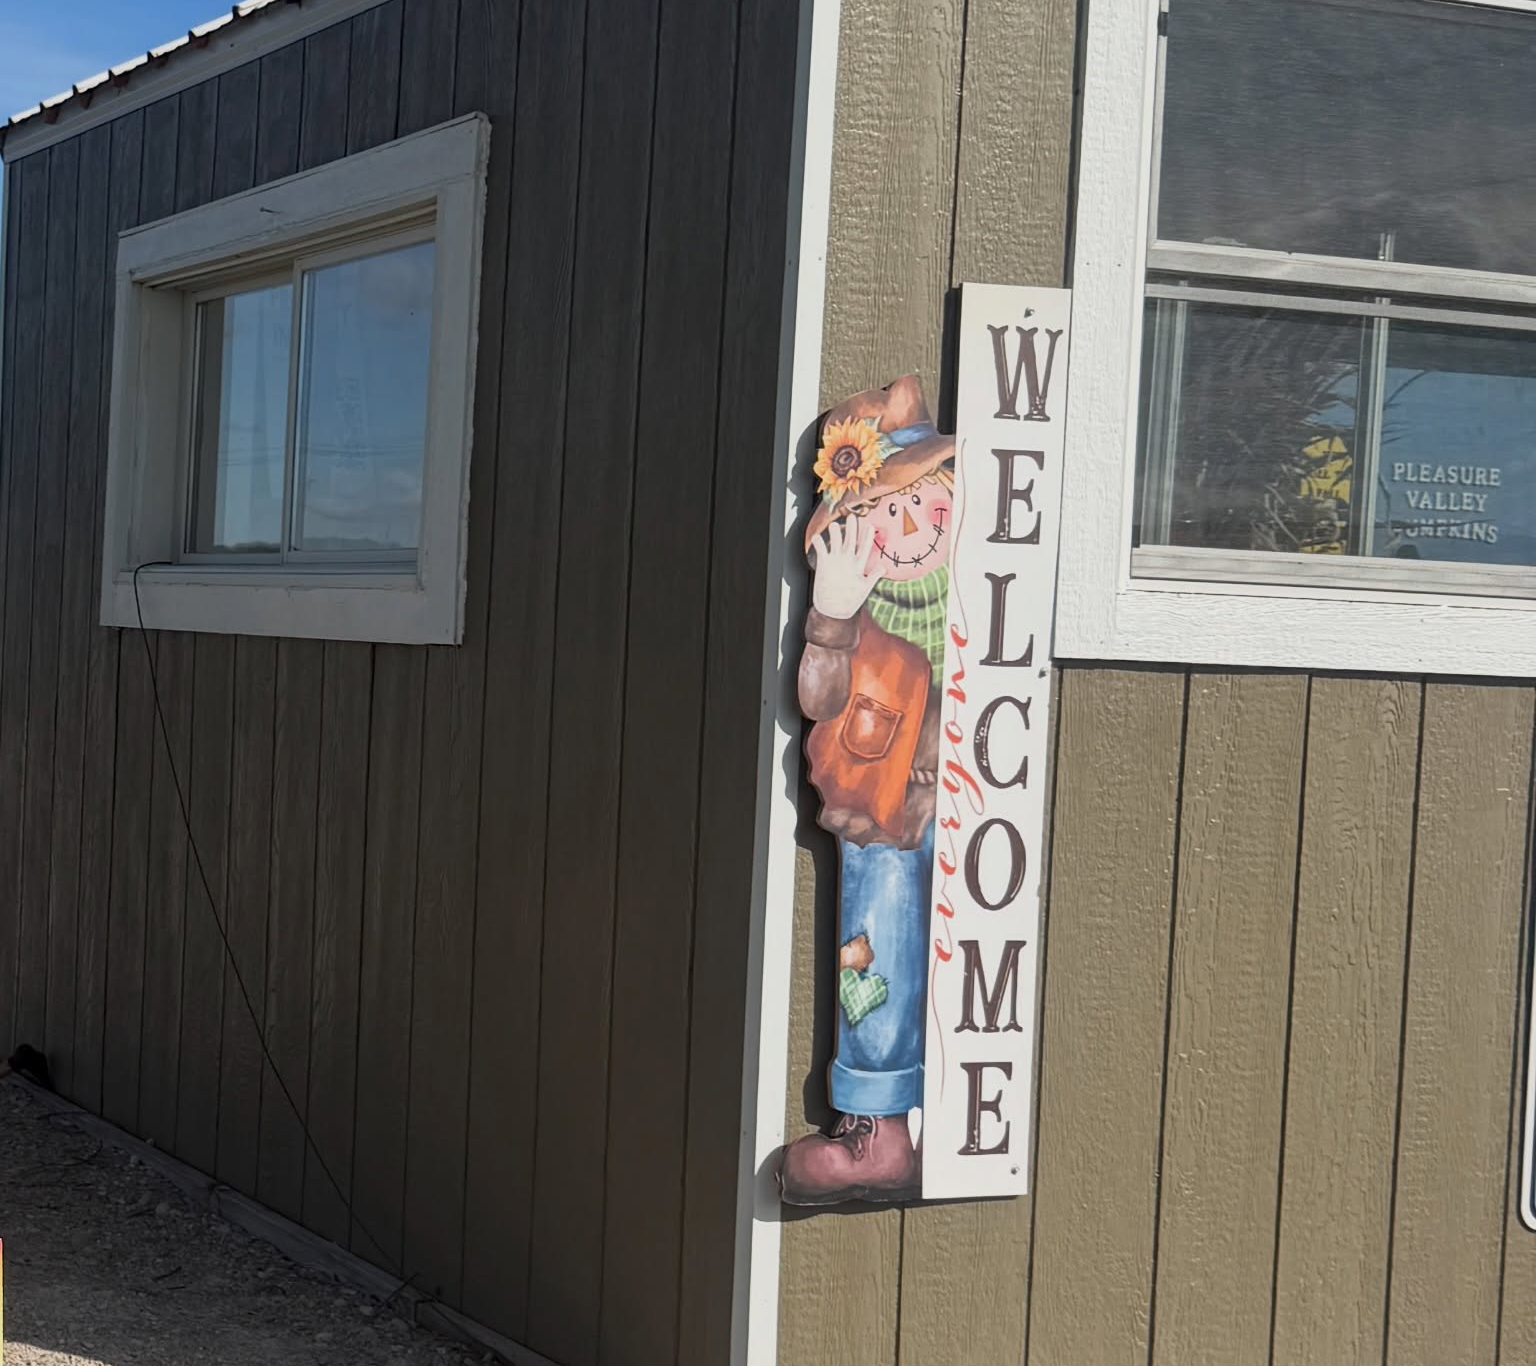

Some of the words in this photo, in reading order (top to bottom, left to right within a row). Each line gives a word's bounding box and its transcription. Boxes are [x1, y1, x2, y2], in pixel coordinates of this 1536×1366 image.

[1392, 462, 1502, 487] PLEASURE
[1406, 490, 1488, 512] VALLEY
[933, 611, 985, 973] everyone
[954, 324, 1062, 1156] WELCOME
